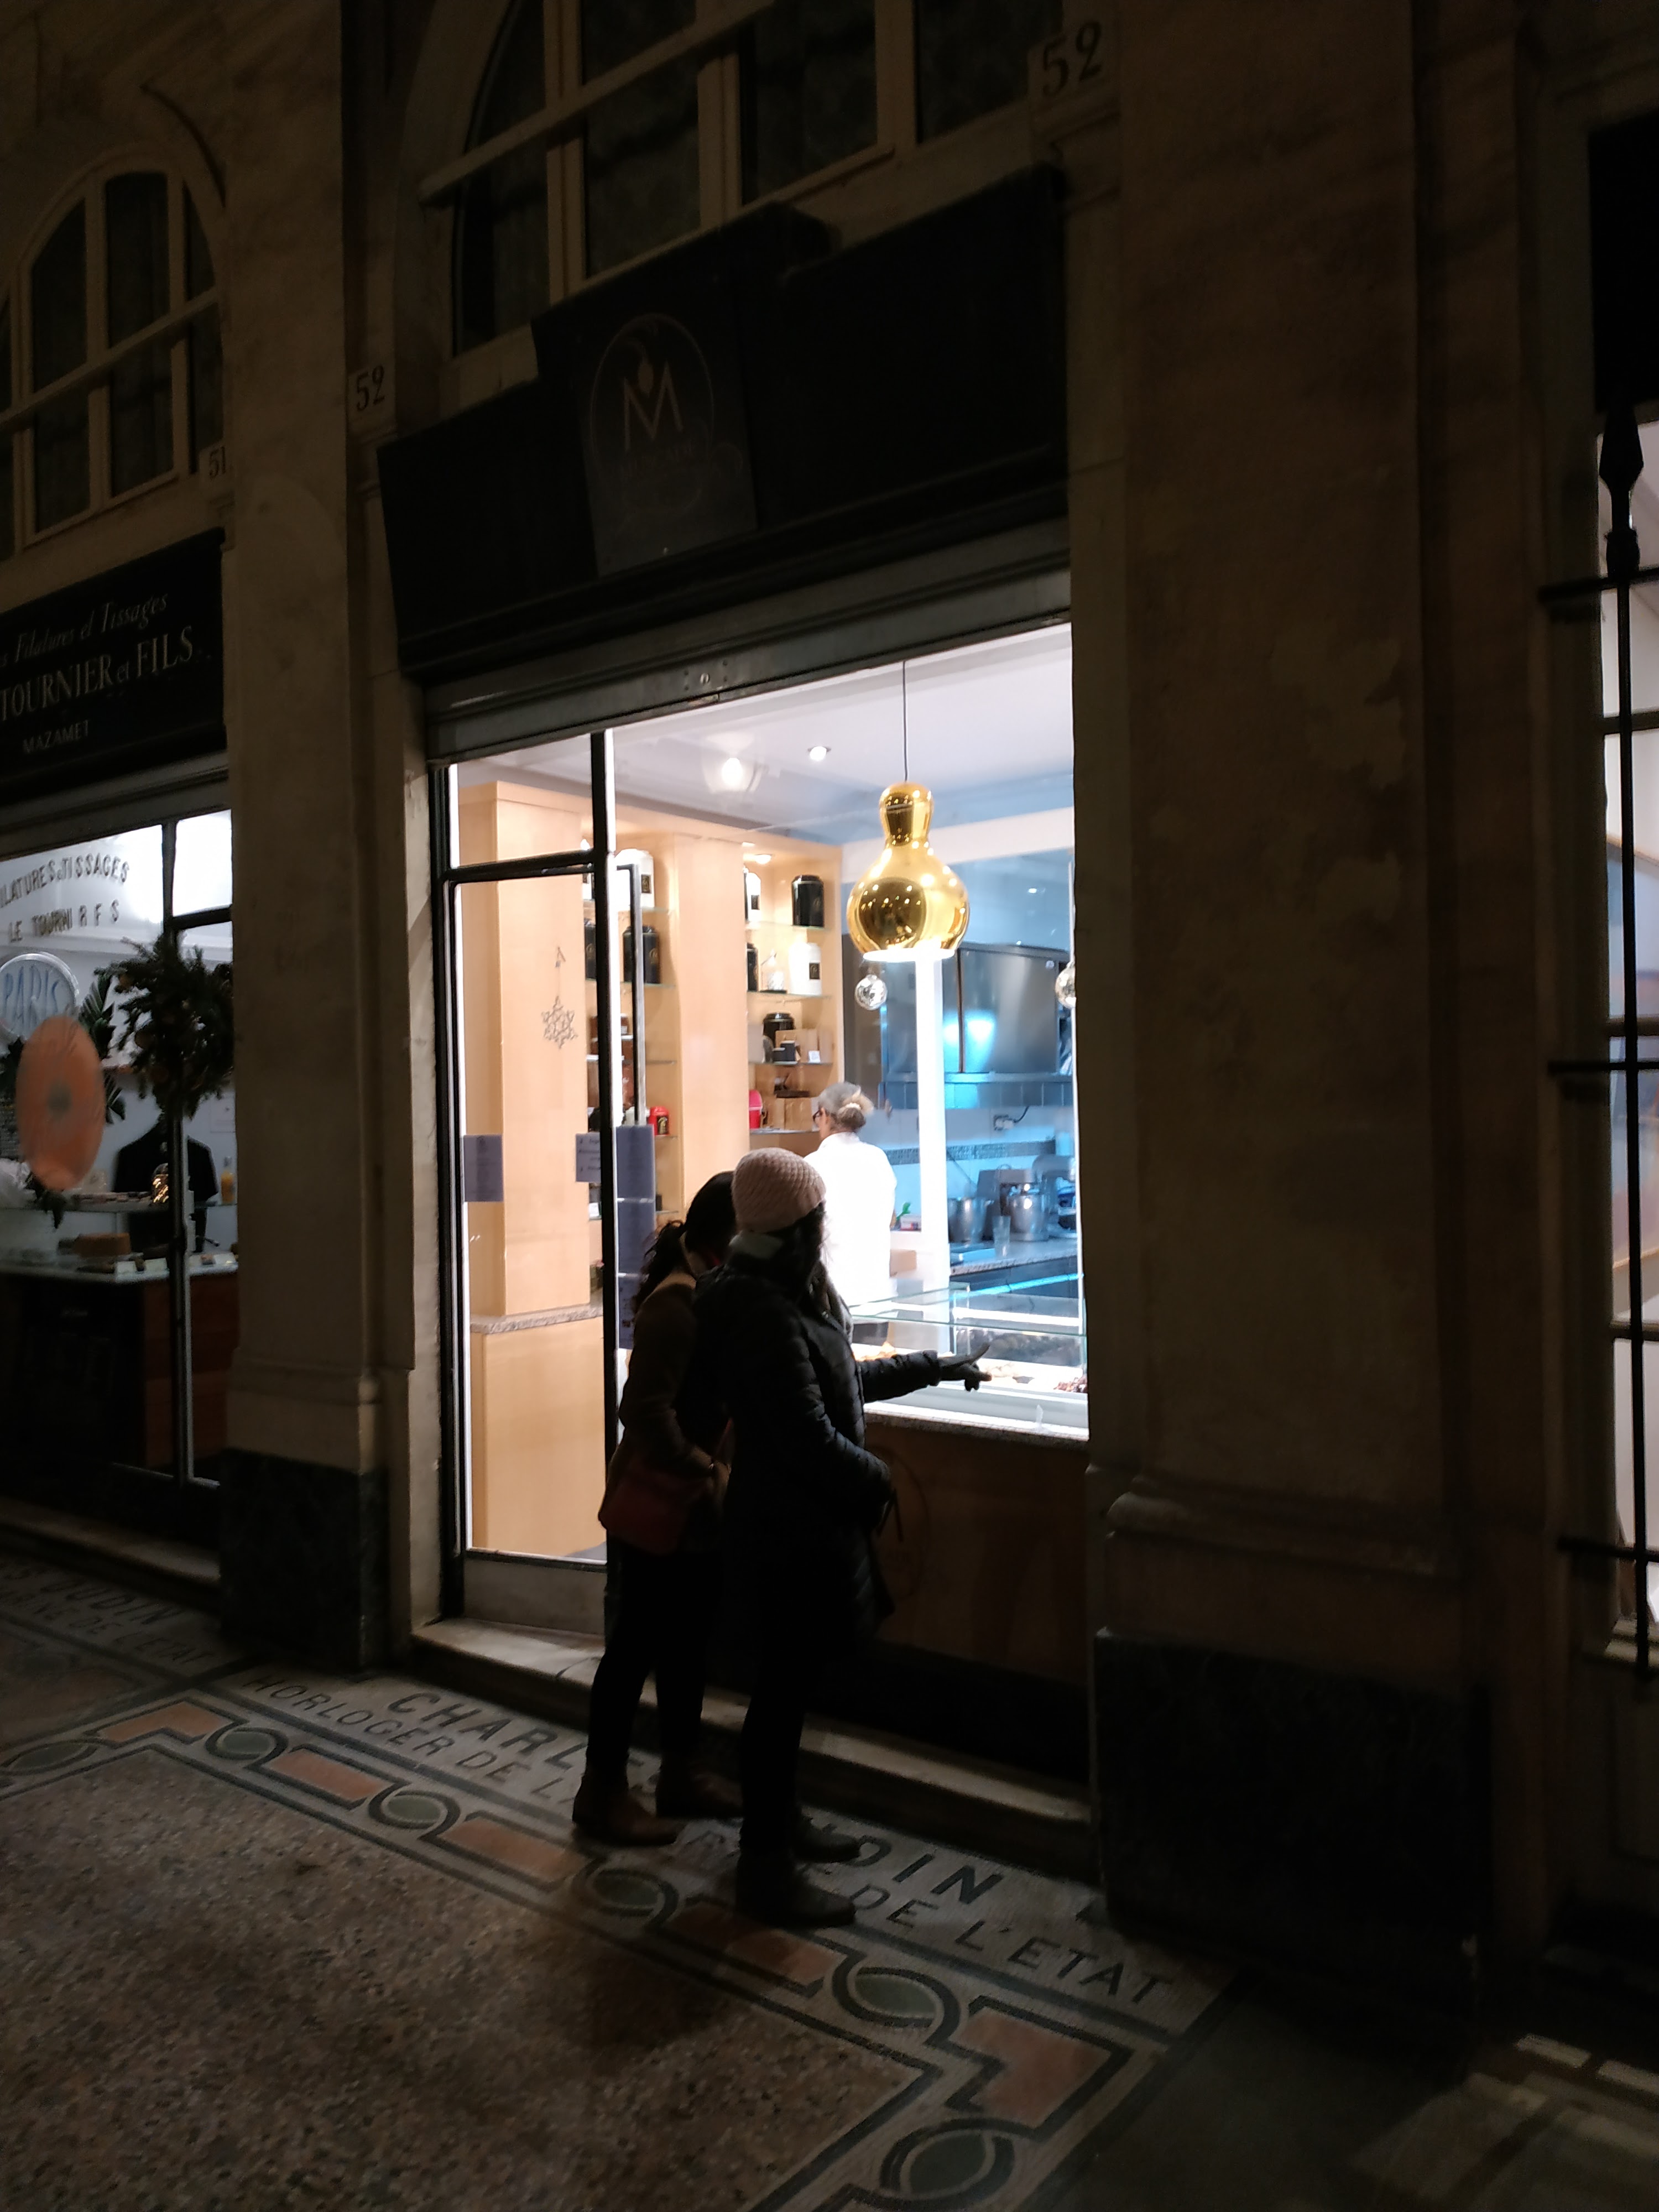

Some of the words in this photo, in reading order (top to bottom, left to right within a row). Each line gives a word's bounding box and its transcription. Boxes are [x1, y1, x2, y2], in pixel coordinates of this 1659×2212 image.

[1043, 21, 1102, 97] 52
[356, 365, 385, 411] 52
[100, 593, 169, 633] Tissages
[0, 653, 114, 721] TOURNIER
[22, 719, 90, 755] MAZAMET
[243, 1674, 456, 1757] HORLOGER
[455, 1750, 531, 1783] DE
[387, 1692, 644, 1771] CHARL
[830, 1826, 1002, 1906] DIN
